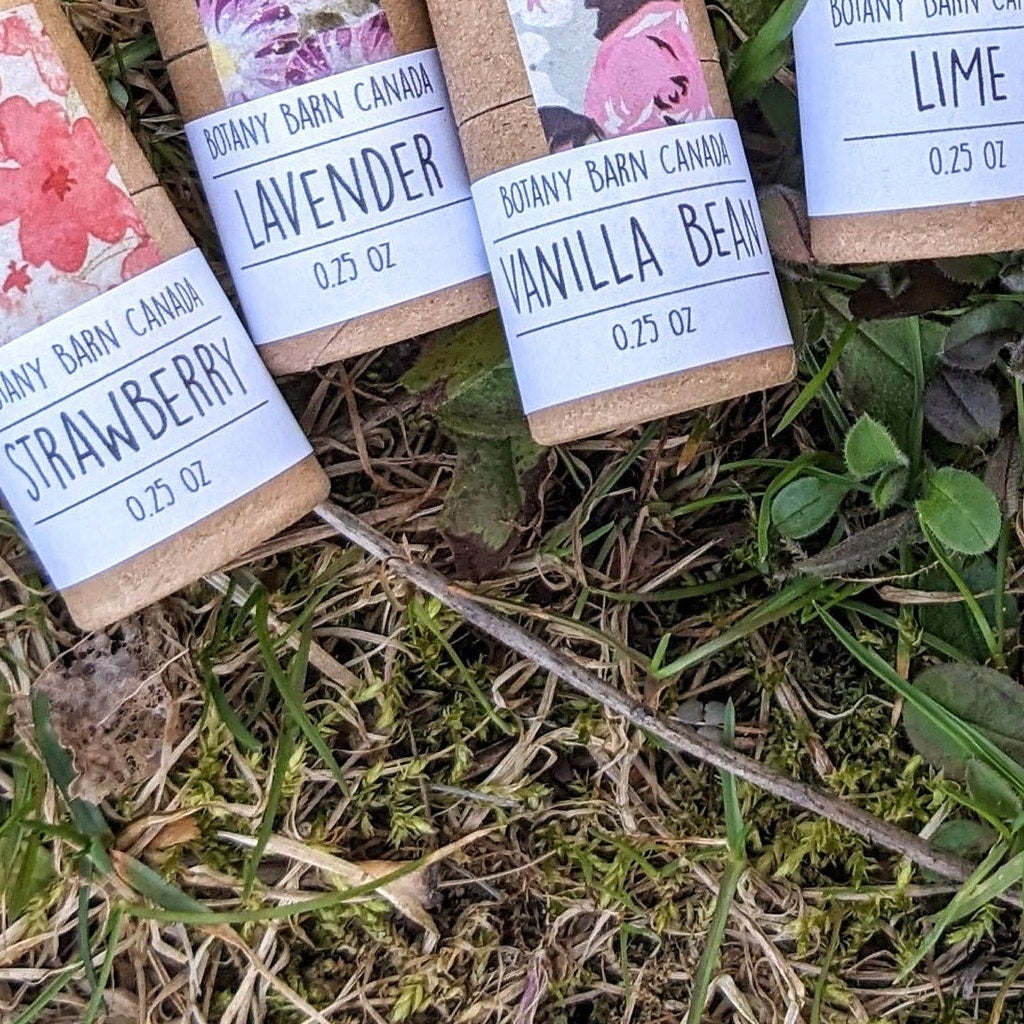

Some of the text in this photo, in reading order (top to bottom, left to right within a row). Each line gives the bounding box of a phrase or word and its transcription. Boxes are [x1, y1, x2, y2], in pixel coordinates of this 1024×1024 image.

[203, 62, 434, 160] BOTANY BARN CANADA
[910, 45, 1008, 113] LIME
[234, 132, 444, 250] LAVENDER
[499, 132, 732, 219] BOTANY BARN CANADA
[928, 140, 1006, 175] 0.25 OZ
[312, 241, 397, 291] 0.25 OZ
[499, 196, 763, 315] VANILLA BEAN
[51, 319, 121, 375] BARN
[125, 276, 204, 337] CANADA
[611, 306, 698, 352] 0.25 OZ
[3, 336, 249, 504] STRAWBERRY
[125, 459, 213, 523] 0.25 OZ
